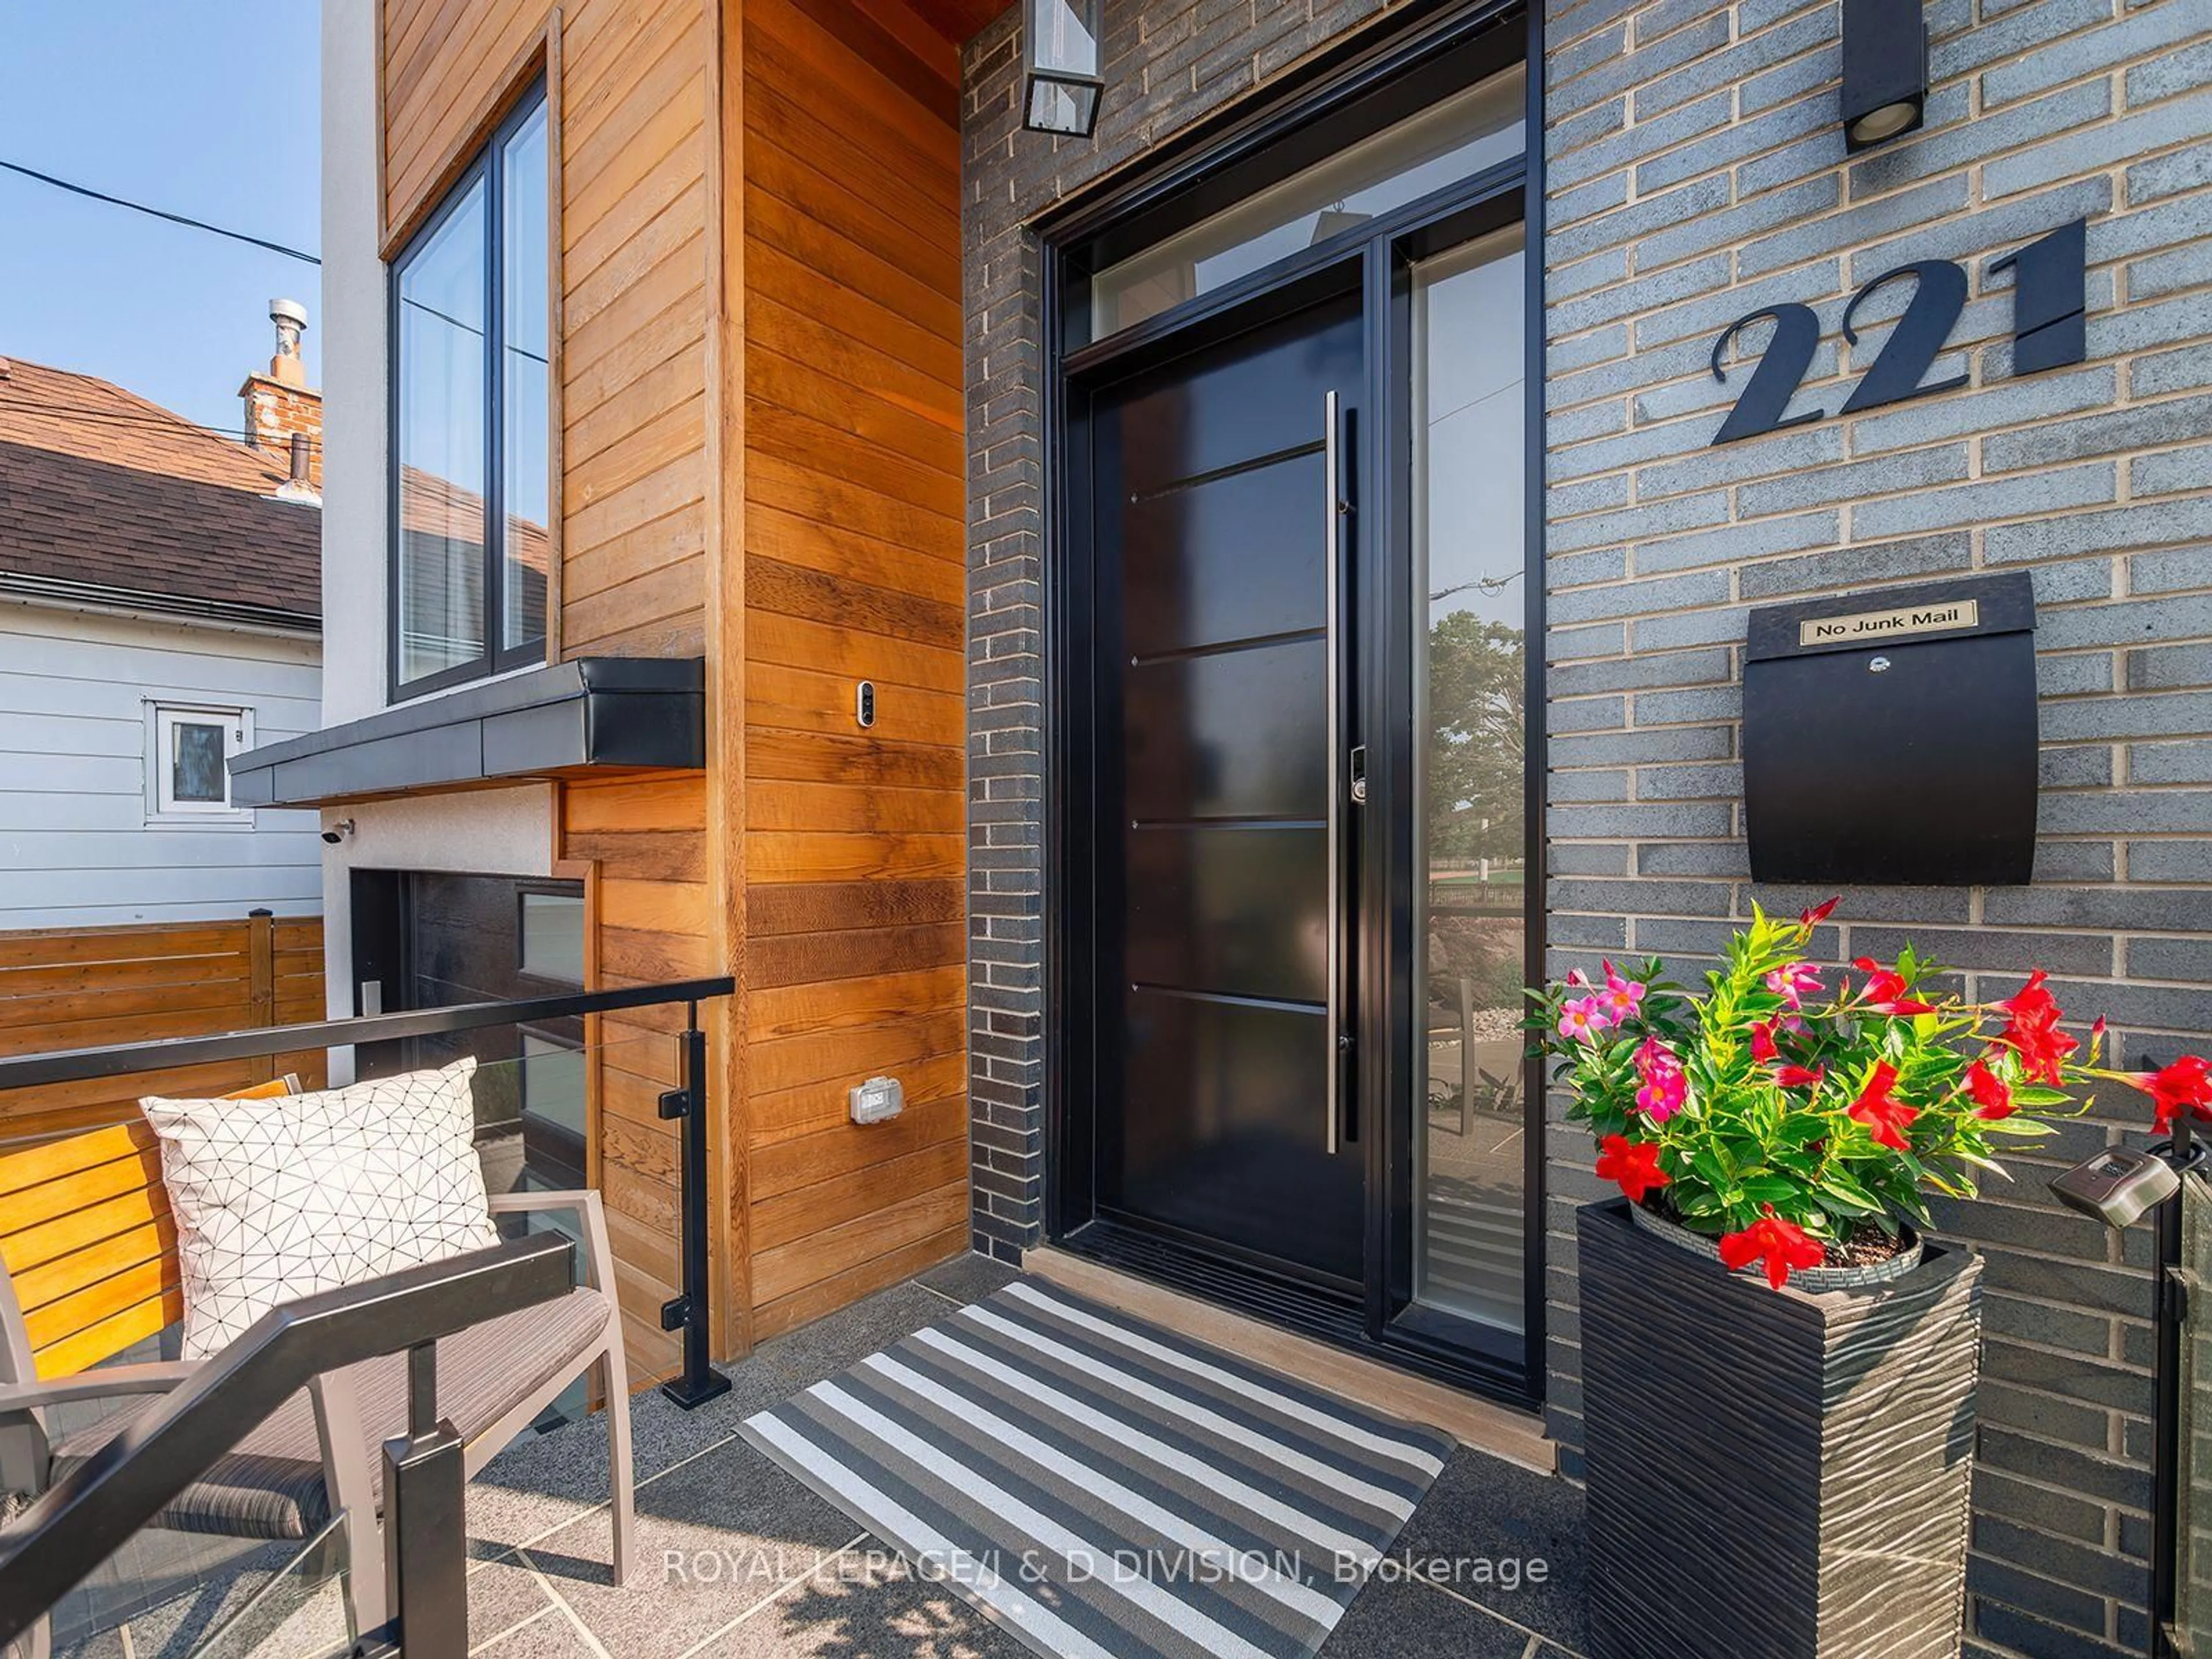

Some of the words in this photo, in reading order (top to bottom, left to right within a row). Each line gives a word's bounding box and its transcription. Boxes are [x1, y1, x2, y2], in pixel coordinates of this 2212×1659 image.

[1710, 217, 2086, 446] 221
[1816, 624, 1847, 637] No
[1853, 616, 1904, 632] Junk
[1912, 609, 1959, 626] Mail
